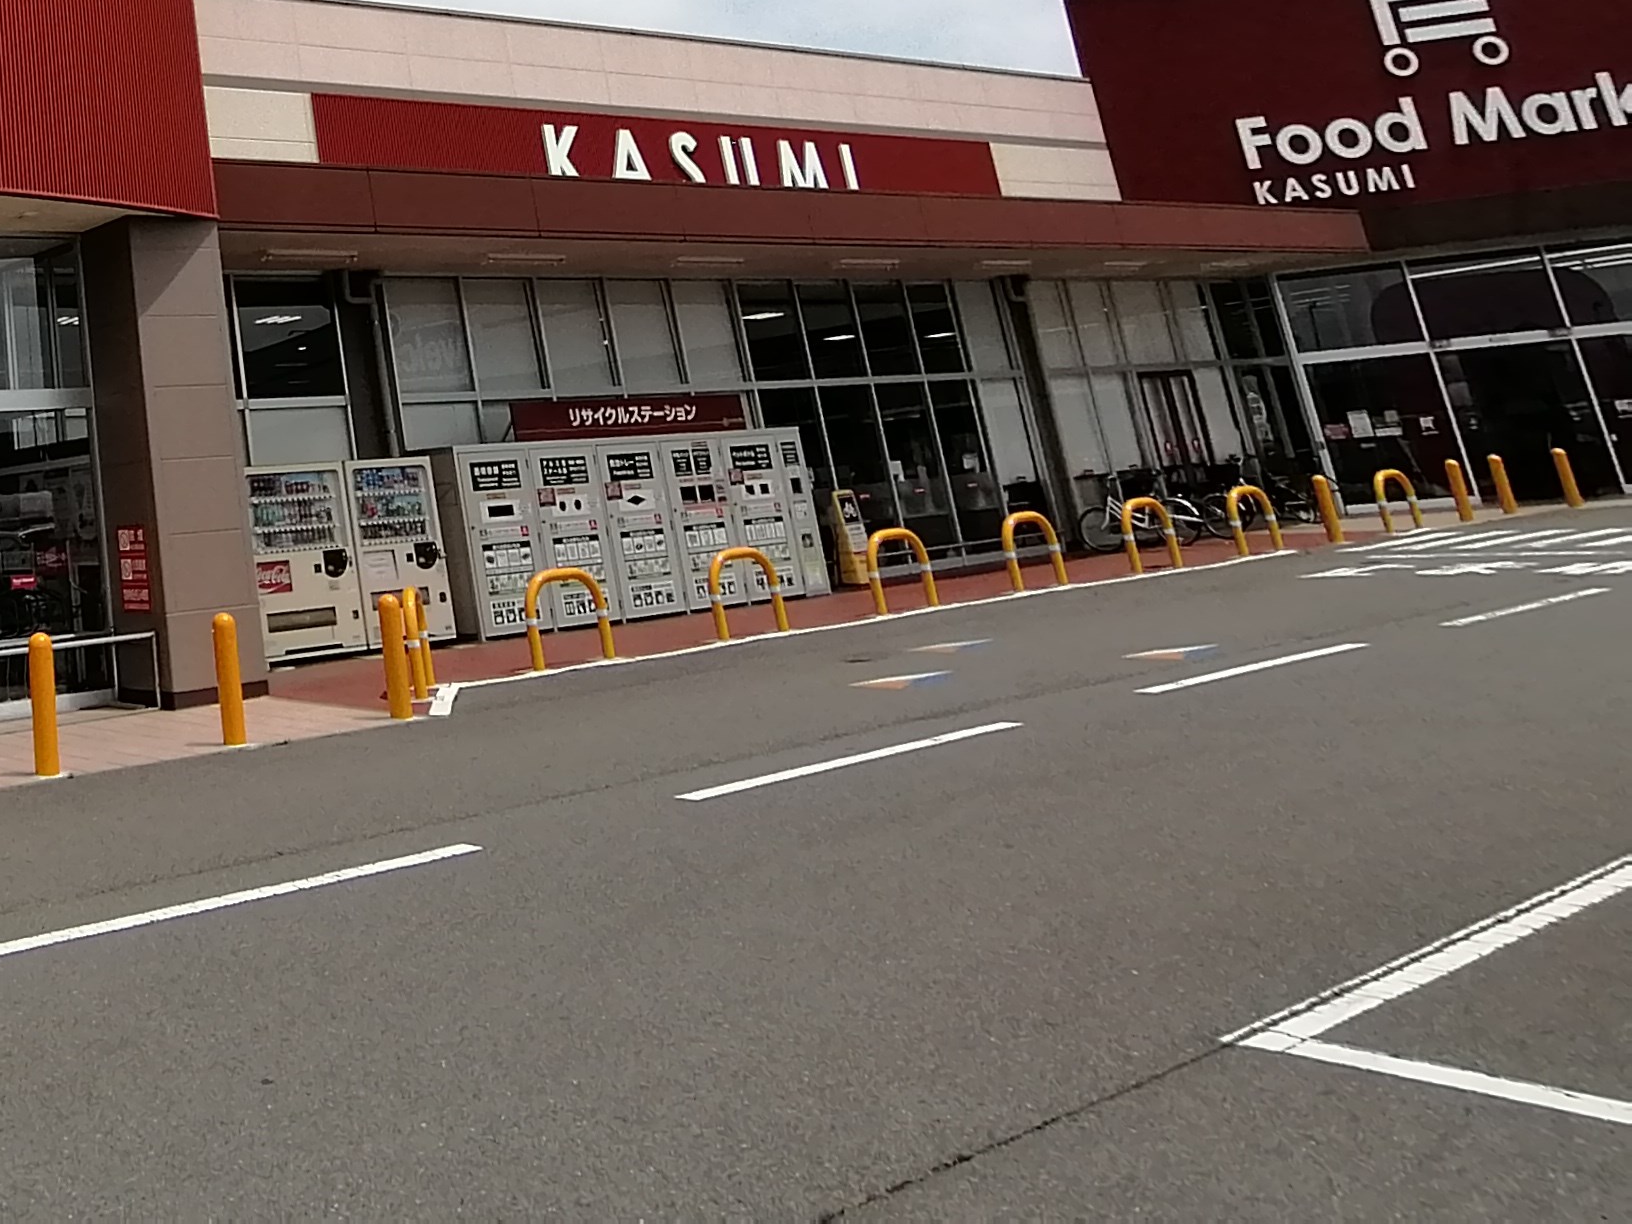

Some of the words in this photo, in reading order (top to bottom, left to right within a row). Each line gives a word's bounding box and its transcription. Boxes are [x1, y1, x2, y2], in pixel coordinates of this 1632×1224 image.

[541, 123, 860, 191] KASUMI
[1234, 96, 1429, 170] Food
[1252, 163, 1417, 206] KASUMI
[568, 404, 696, 427] リサイクルステーション
